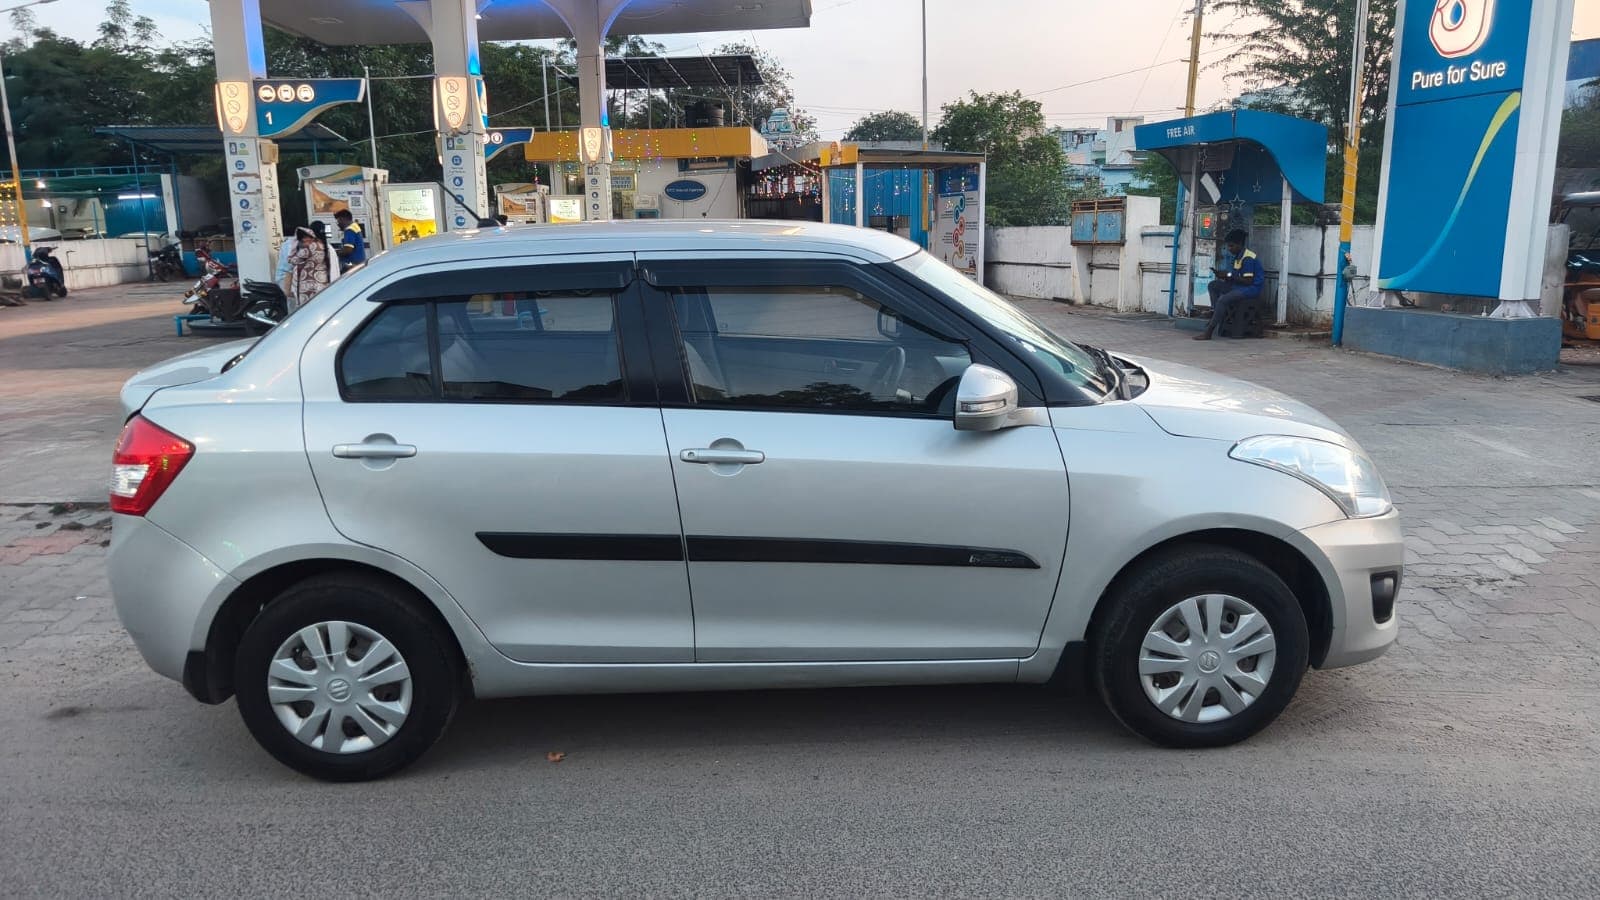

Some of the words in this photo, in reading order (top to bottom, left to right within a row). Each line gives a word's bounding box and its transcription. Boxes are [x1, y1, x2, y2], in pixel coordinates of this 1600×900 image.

[1411, 71, 1443, 90] Pure
[1447, 65, 1467, 85] for
[1470, 61, 1506, 81] Sure
[265, 111, 273, 125] 1
[1166, 127, 1182, 139] FREE
[1183, 125, 1195, 137] AIR
